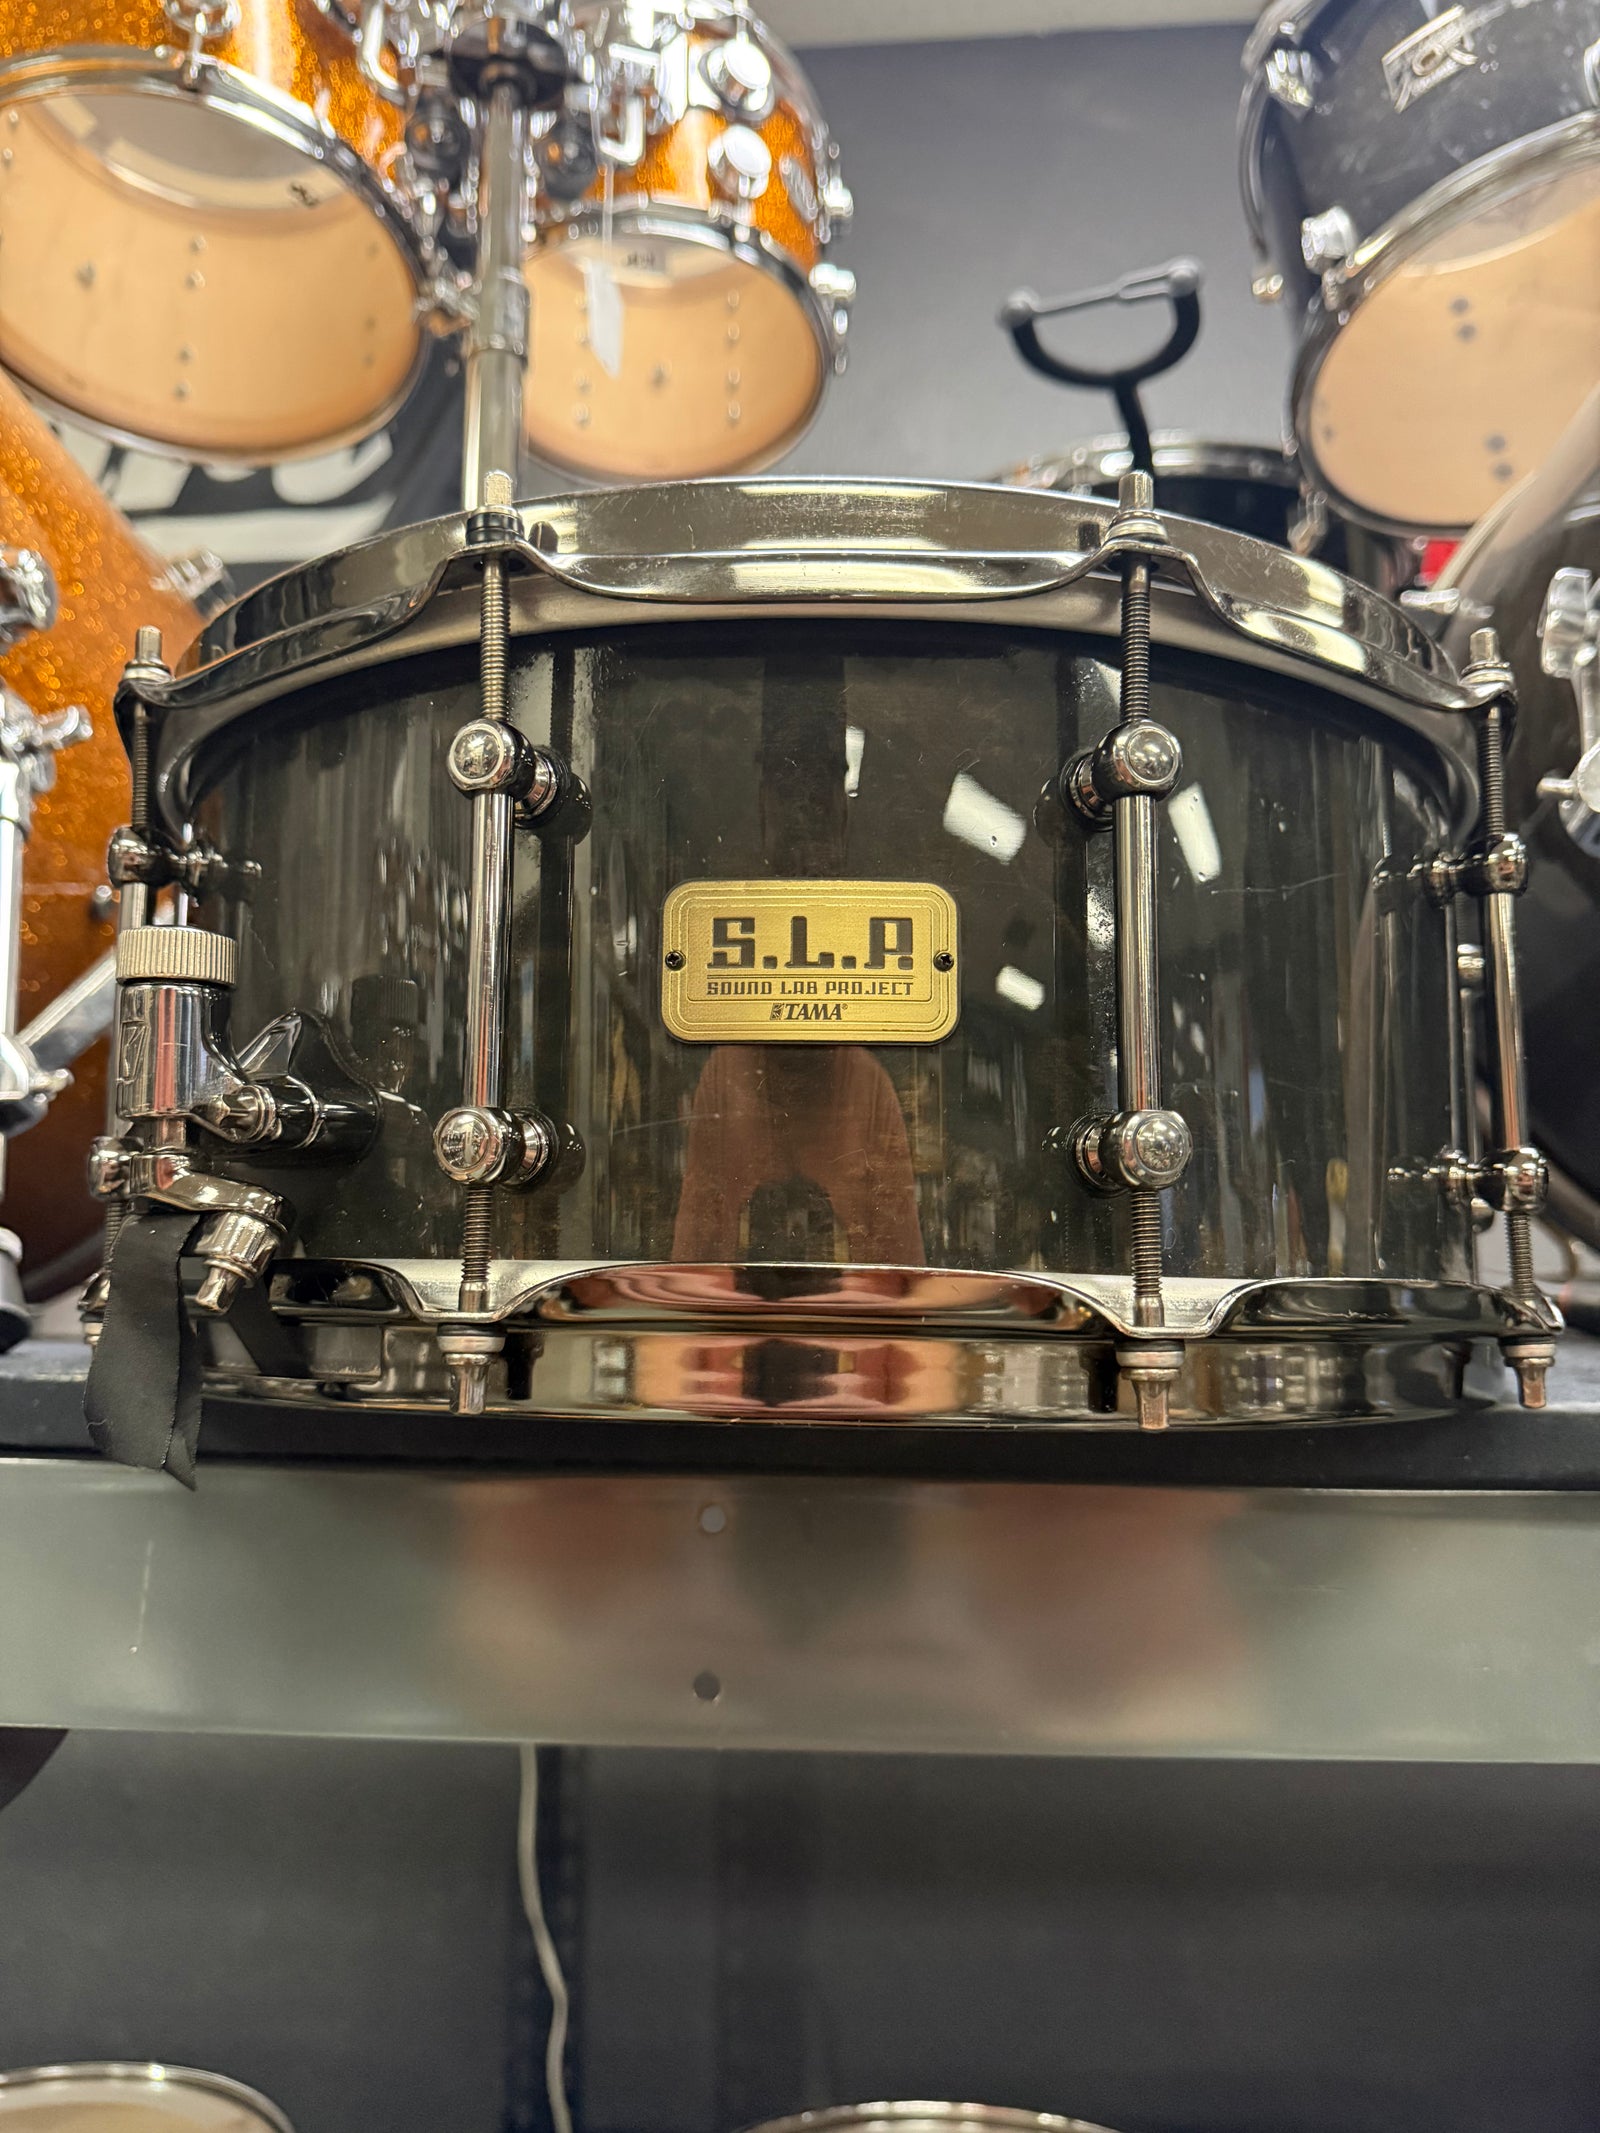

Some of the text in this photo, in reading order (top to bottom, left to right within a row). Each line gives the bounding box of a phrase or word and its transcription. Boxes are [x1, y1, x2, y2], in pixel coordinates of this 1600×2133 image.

[707, 915, 914, 970] S.L.P.
[706, 981, 914, 996] SOUND LAB PROJECT
